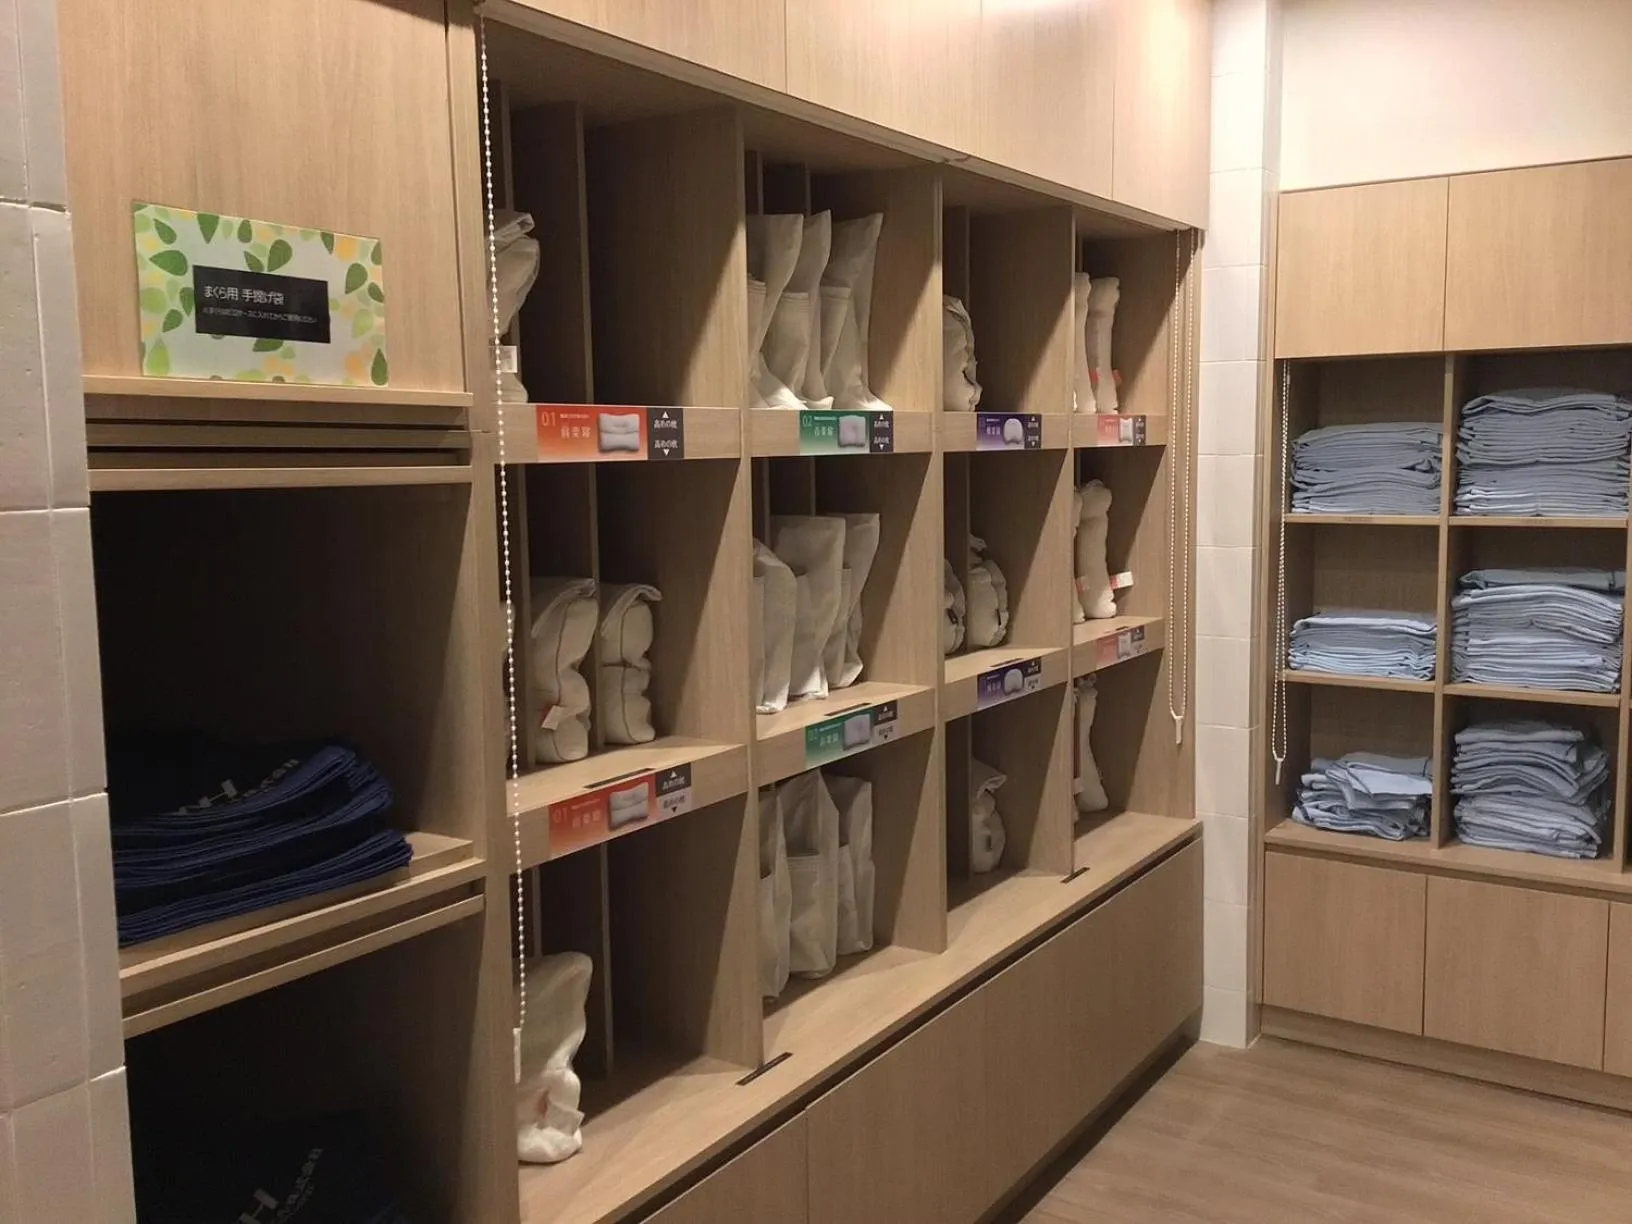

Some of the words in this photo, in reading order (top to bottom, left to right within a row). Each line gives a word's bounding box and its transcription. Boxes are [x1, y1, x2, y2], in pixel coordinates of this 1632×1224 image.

[203, 285, 239, 301] まくら用
[541, 411, 556, 427] 01
